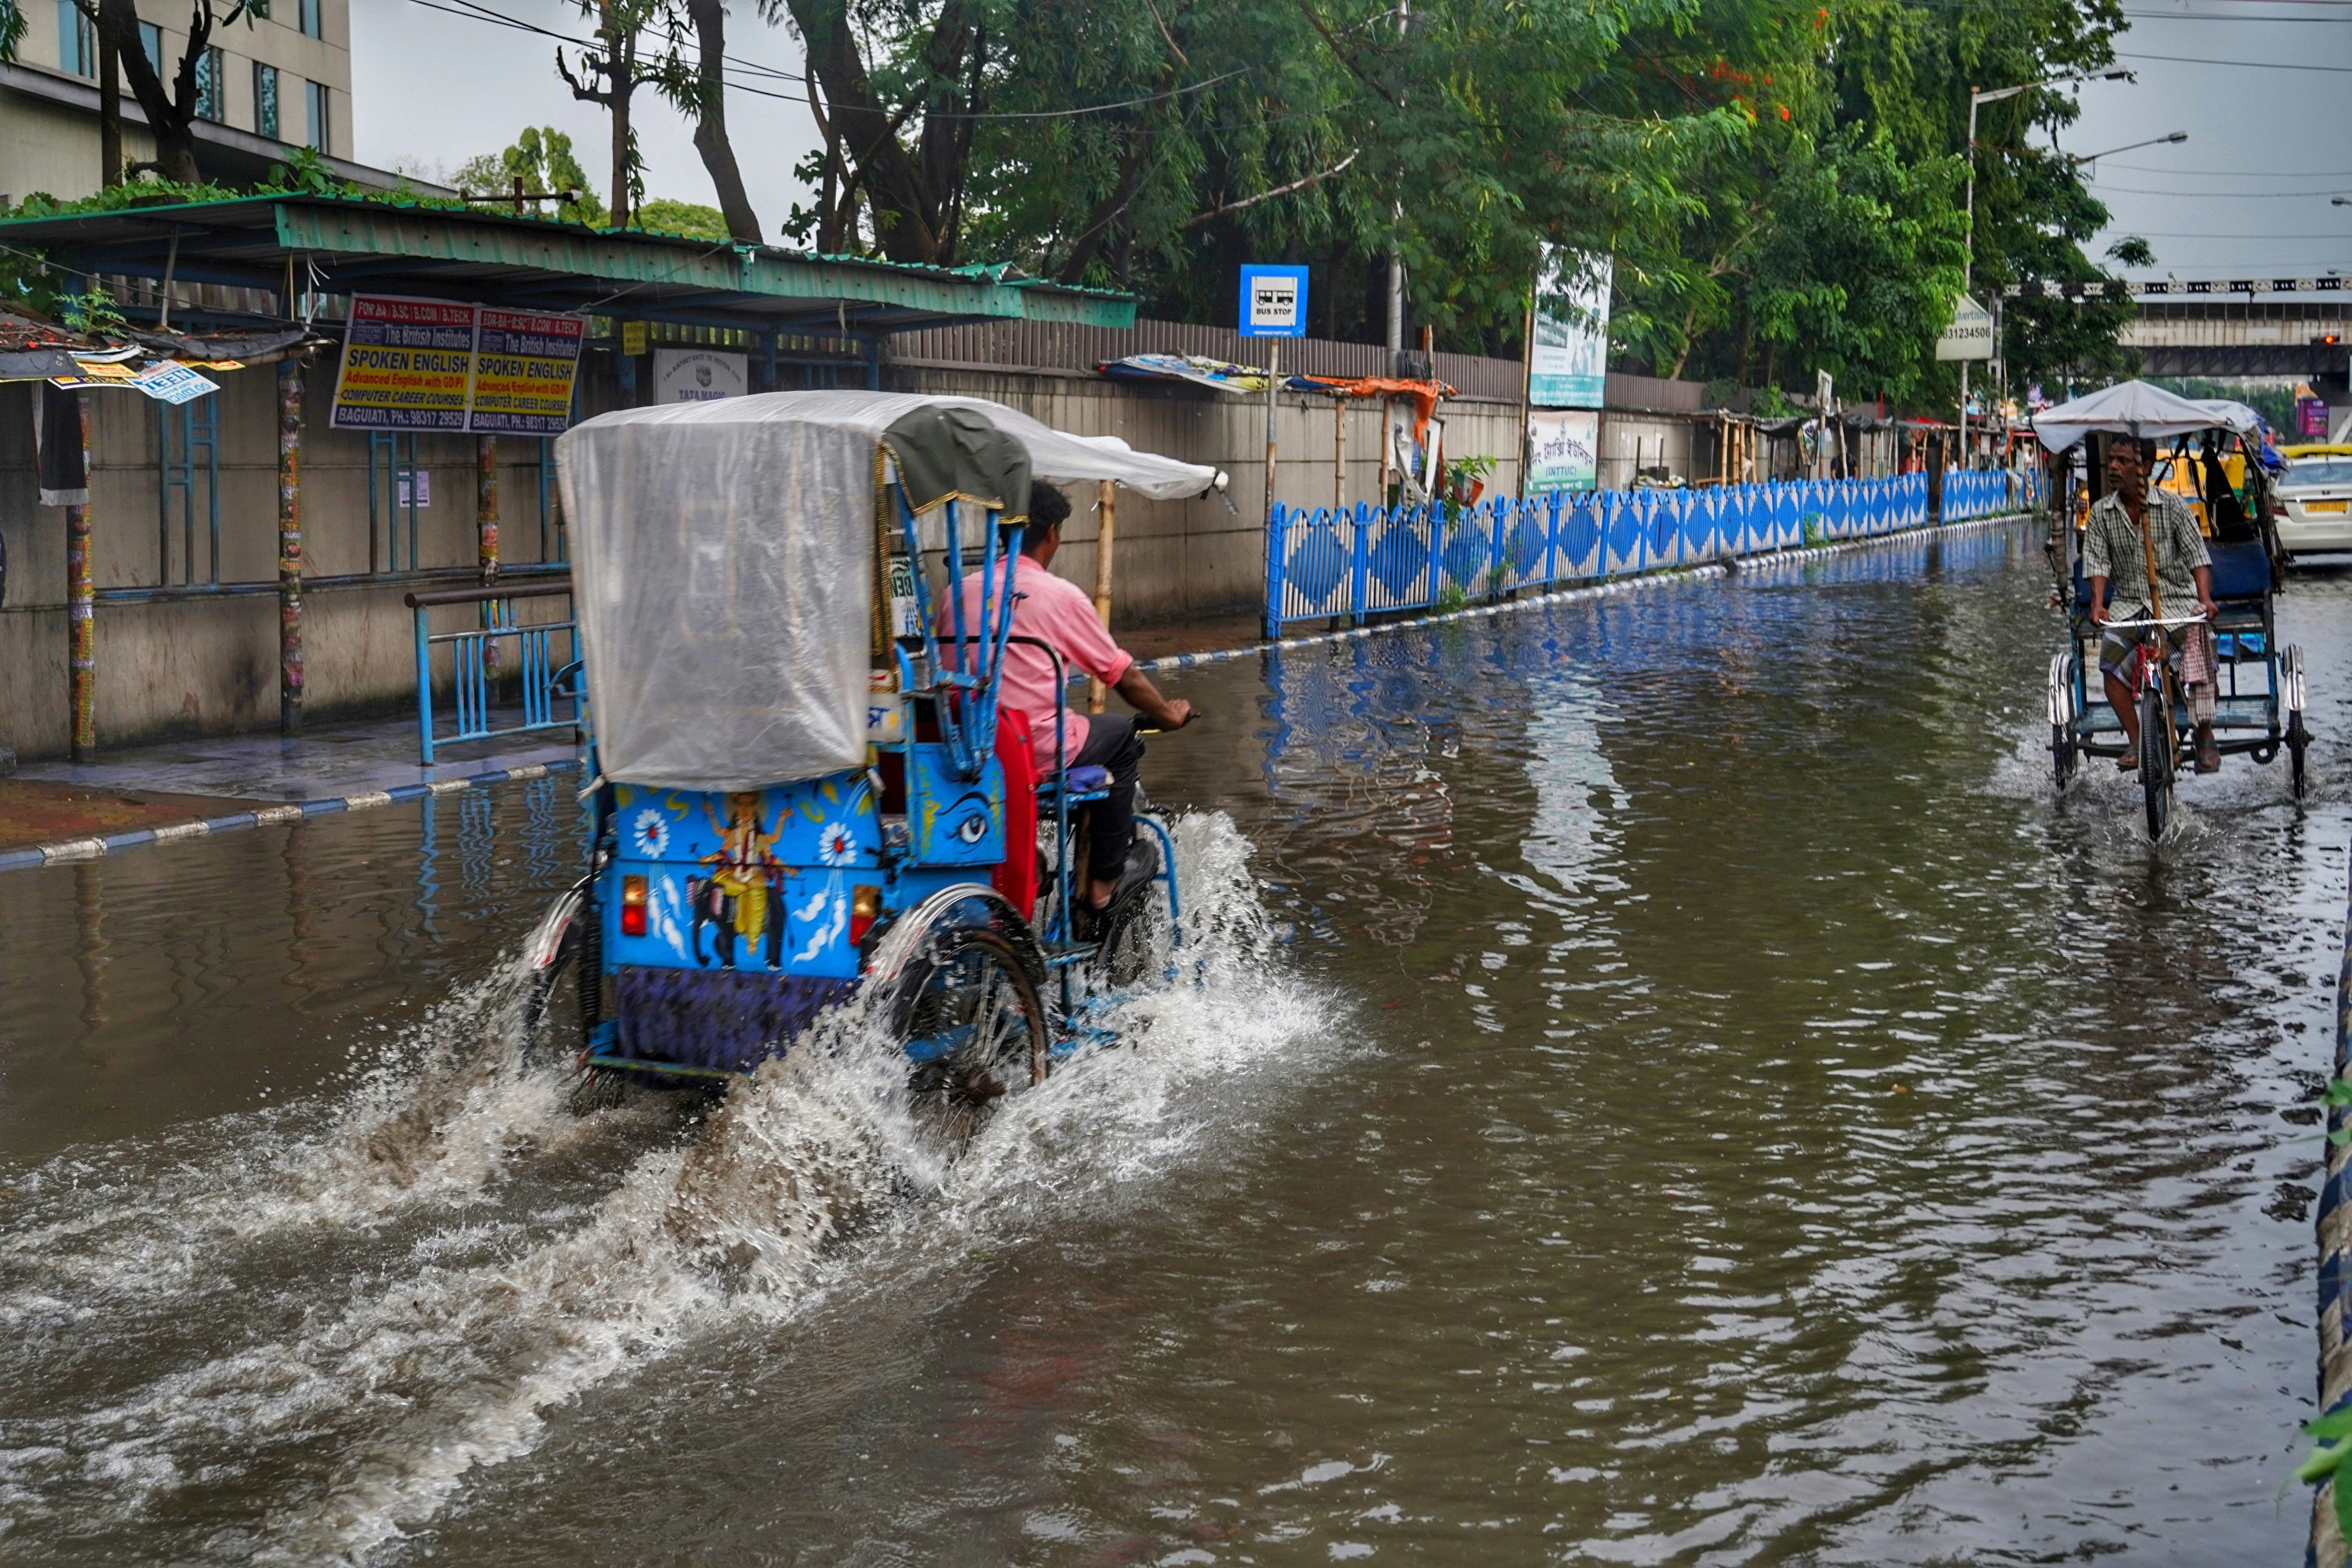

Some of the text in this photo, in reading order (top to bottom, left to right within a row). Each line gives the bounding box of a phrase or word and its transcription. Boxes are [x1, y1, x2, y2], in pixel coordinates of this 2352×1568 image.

[358, 301, 375, 316] FOR
[375, 304, 386, 318] BA
[392, 305, 409, 319] B.SC
[414, 307, 437, 321] B.COM
[443, 308, 470, 324] B.TECH.
[1955, 310, 1990, 322] dvertising
[483, 313, 497, 326] FOR
[498, 315, 507, 327] BA
[511, 317, 527, 330] B.SC
[531, 318, 551, 332] B.COM
[554, 321, 578, 335] B.TECH.
[385, 324, 470, 348] The British Institutes
[505, 333, 577, 357] The British Institutes
[348, 349, 469, 373] SPOKEN ENGLISH
[478, 357, 573, 381] SPOKEN ENGLISH
[148, 369, 193, 392] NEET
[194, 382, 211, 392] GO
[345, 371, 390, 385] Advanced
[392, 373, 423, 388] English
[425, 376, 441, 388] with
[476, 380, 510, 392] Advanced
[512, 381, 535, 395] English
[536, 383, 549, 393] with
[341, 389, 465, 406] COMPUTER CAREER COURSES
[475, 395, 568, 411] COMPUTER CAREER COURSES
[679, 389, 726, 400] TATA MAGIC
[338, 407, 389, 426] BAGUIATI,
[411, 410, 436, 425] 98317
[438, 411, 463, 426] 29529
[473, 413, 510, 430] BAGUIATI,
[525, 416, 545, 429] 98317
[1546, 465, 1576, 479] (INTTUC)
